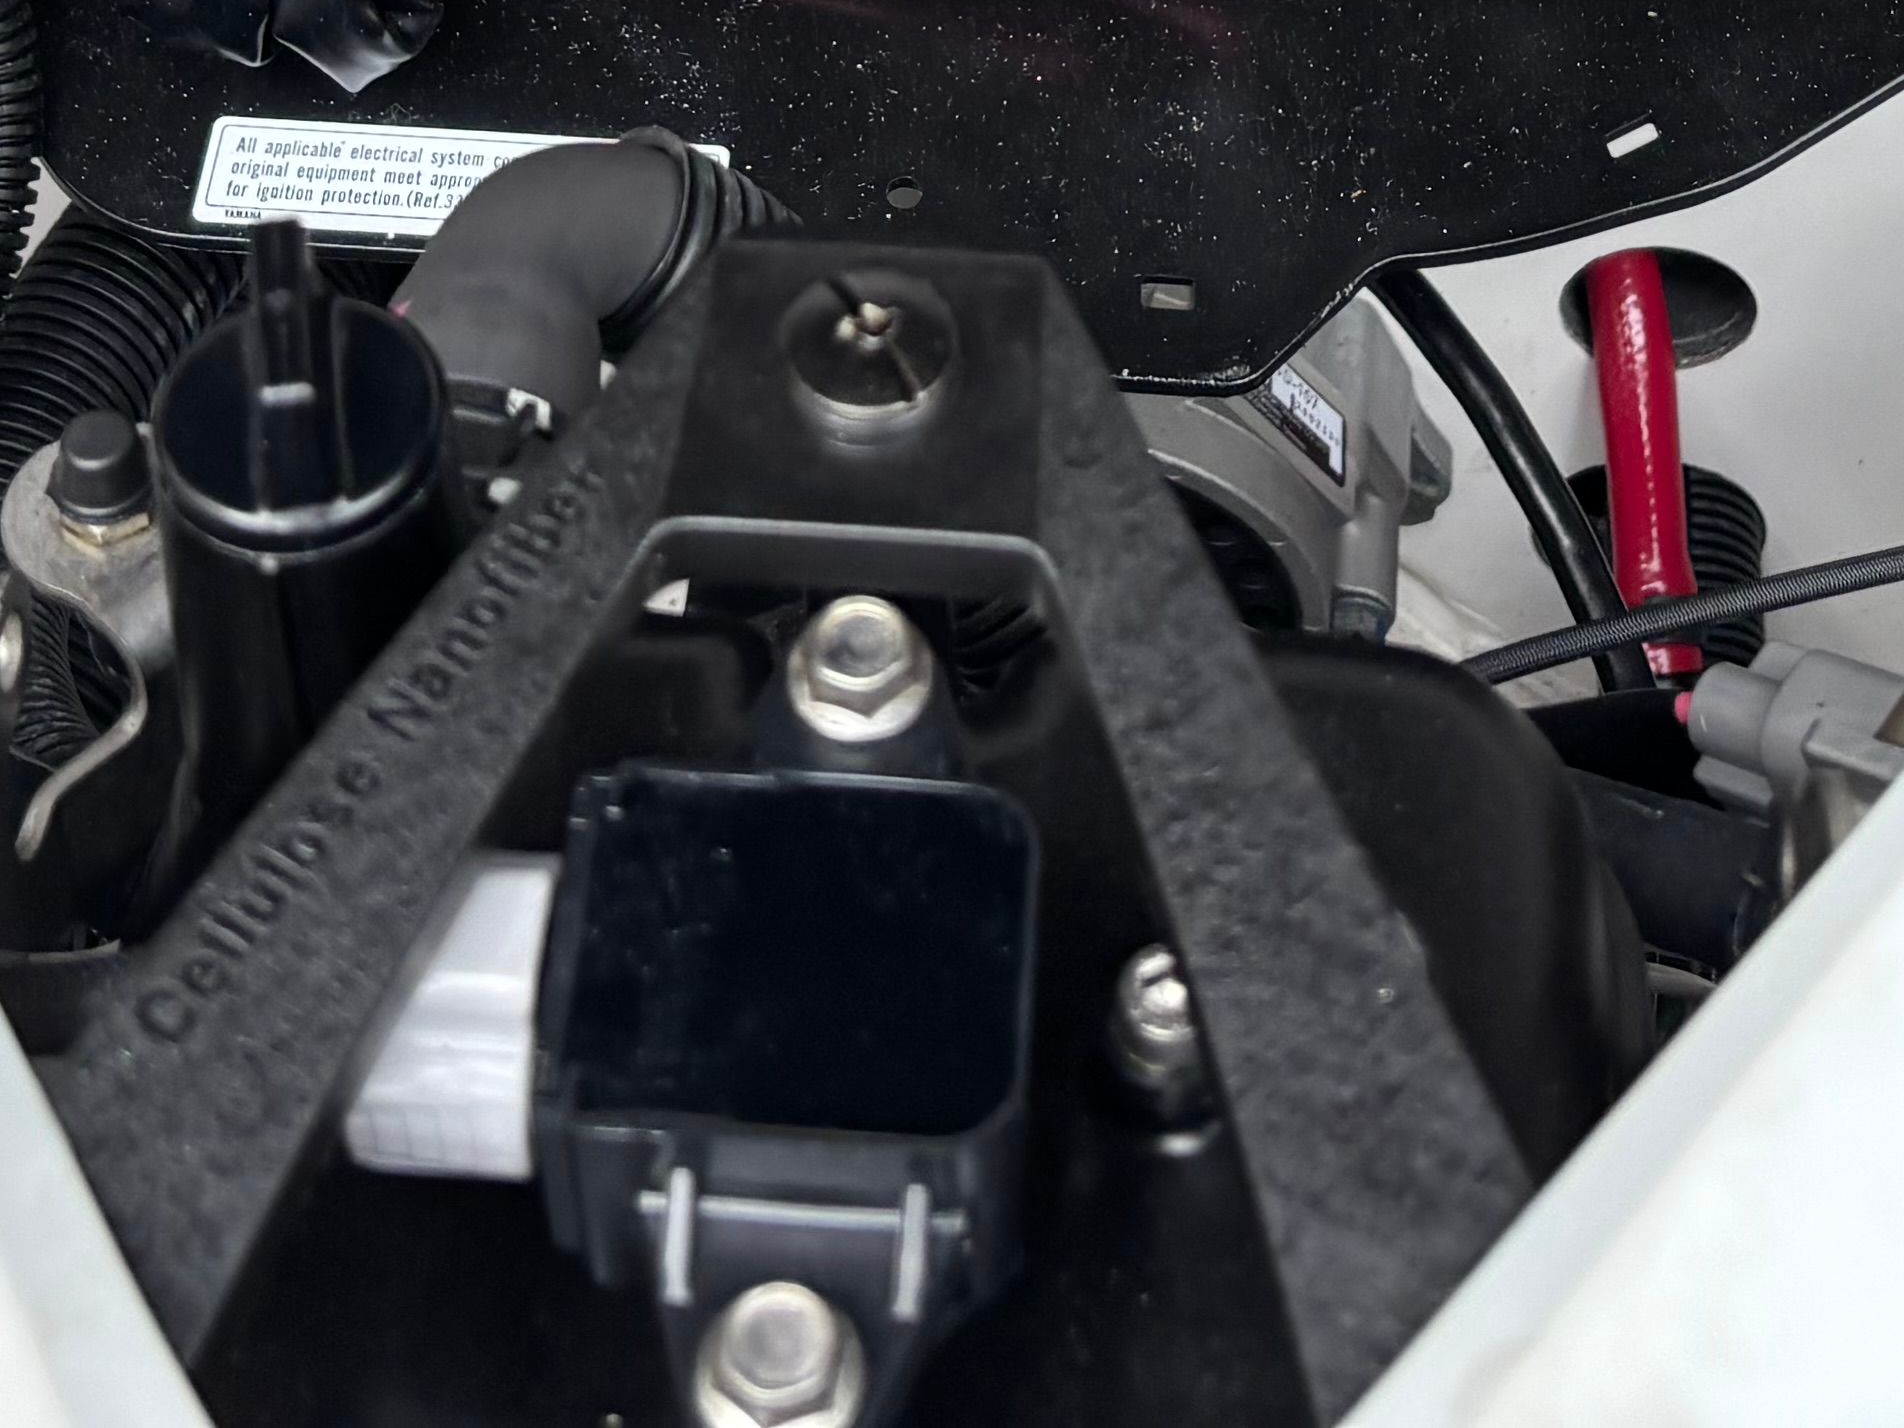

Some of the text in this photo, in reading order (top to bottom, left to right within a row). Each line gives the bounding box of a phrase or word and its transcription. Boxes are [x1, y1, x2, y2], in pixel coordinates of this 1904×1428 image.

[236, 137, 258, 153] All
[264, 139, 342, 160] applicable
[350, 146, 423, 164] electrical
[431, 151, 485, 168] system
[231, 160, 289, 179] original
[297, 164, 376, 186] equipment
[384, 171, 422, 186] meet
[226, 180, 249, 198] for
[256, 182, 314, 202] ignition
[134, 457, 605, 1041] Cellulose Nanofiber
